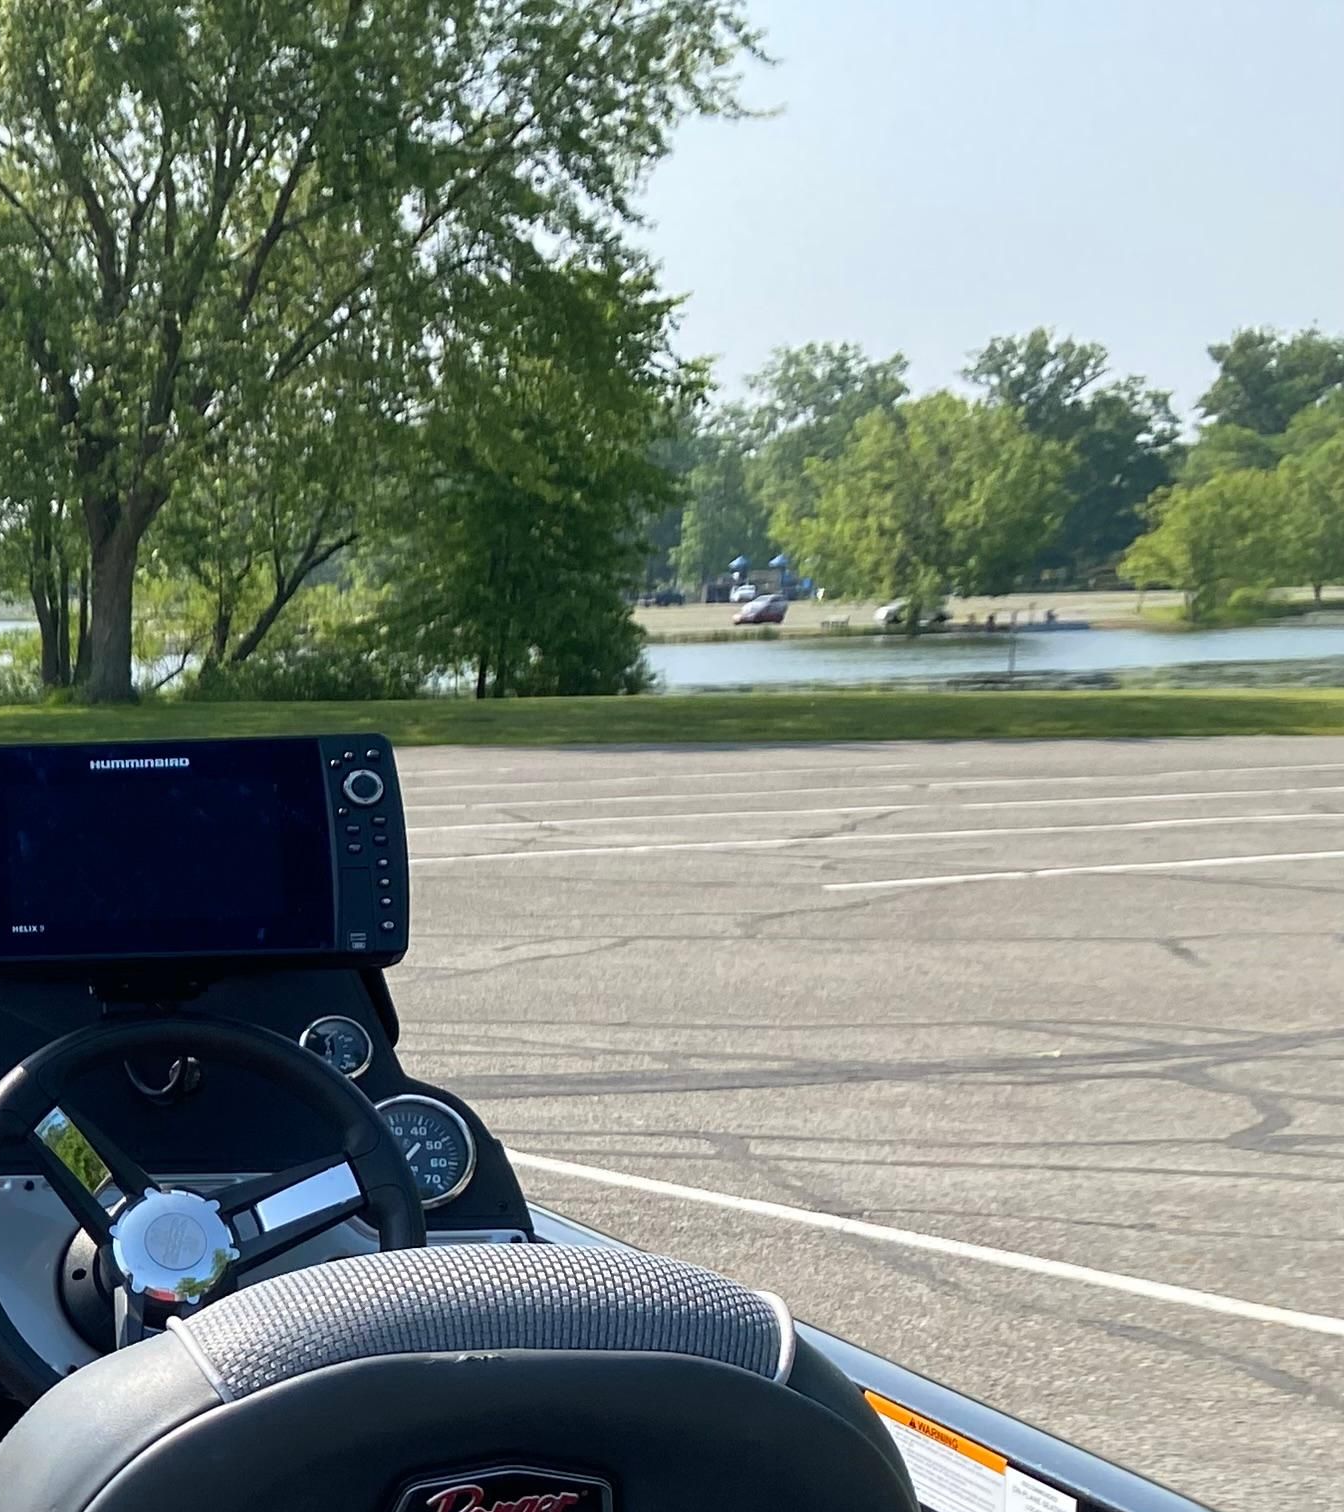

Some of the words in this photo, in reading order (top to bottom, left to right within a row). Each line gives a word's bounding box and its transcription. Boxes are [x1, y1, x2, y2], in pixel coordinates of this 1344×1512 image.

[89, 757, 190, 770] HUMMINBIRD
[11, 924, 38, 933] HELIX
[410, 1126, 427, 1136] 40
[425, 1140, 442, 1150] 50
[430, 1158, 447, 1167] 60
[424, 1174, 441, 1184] 70
[917, 1420, 959, 1450] WARNING
